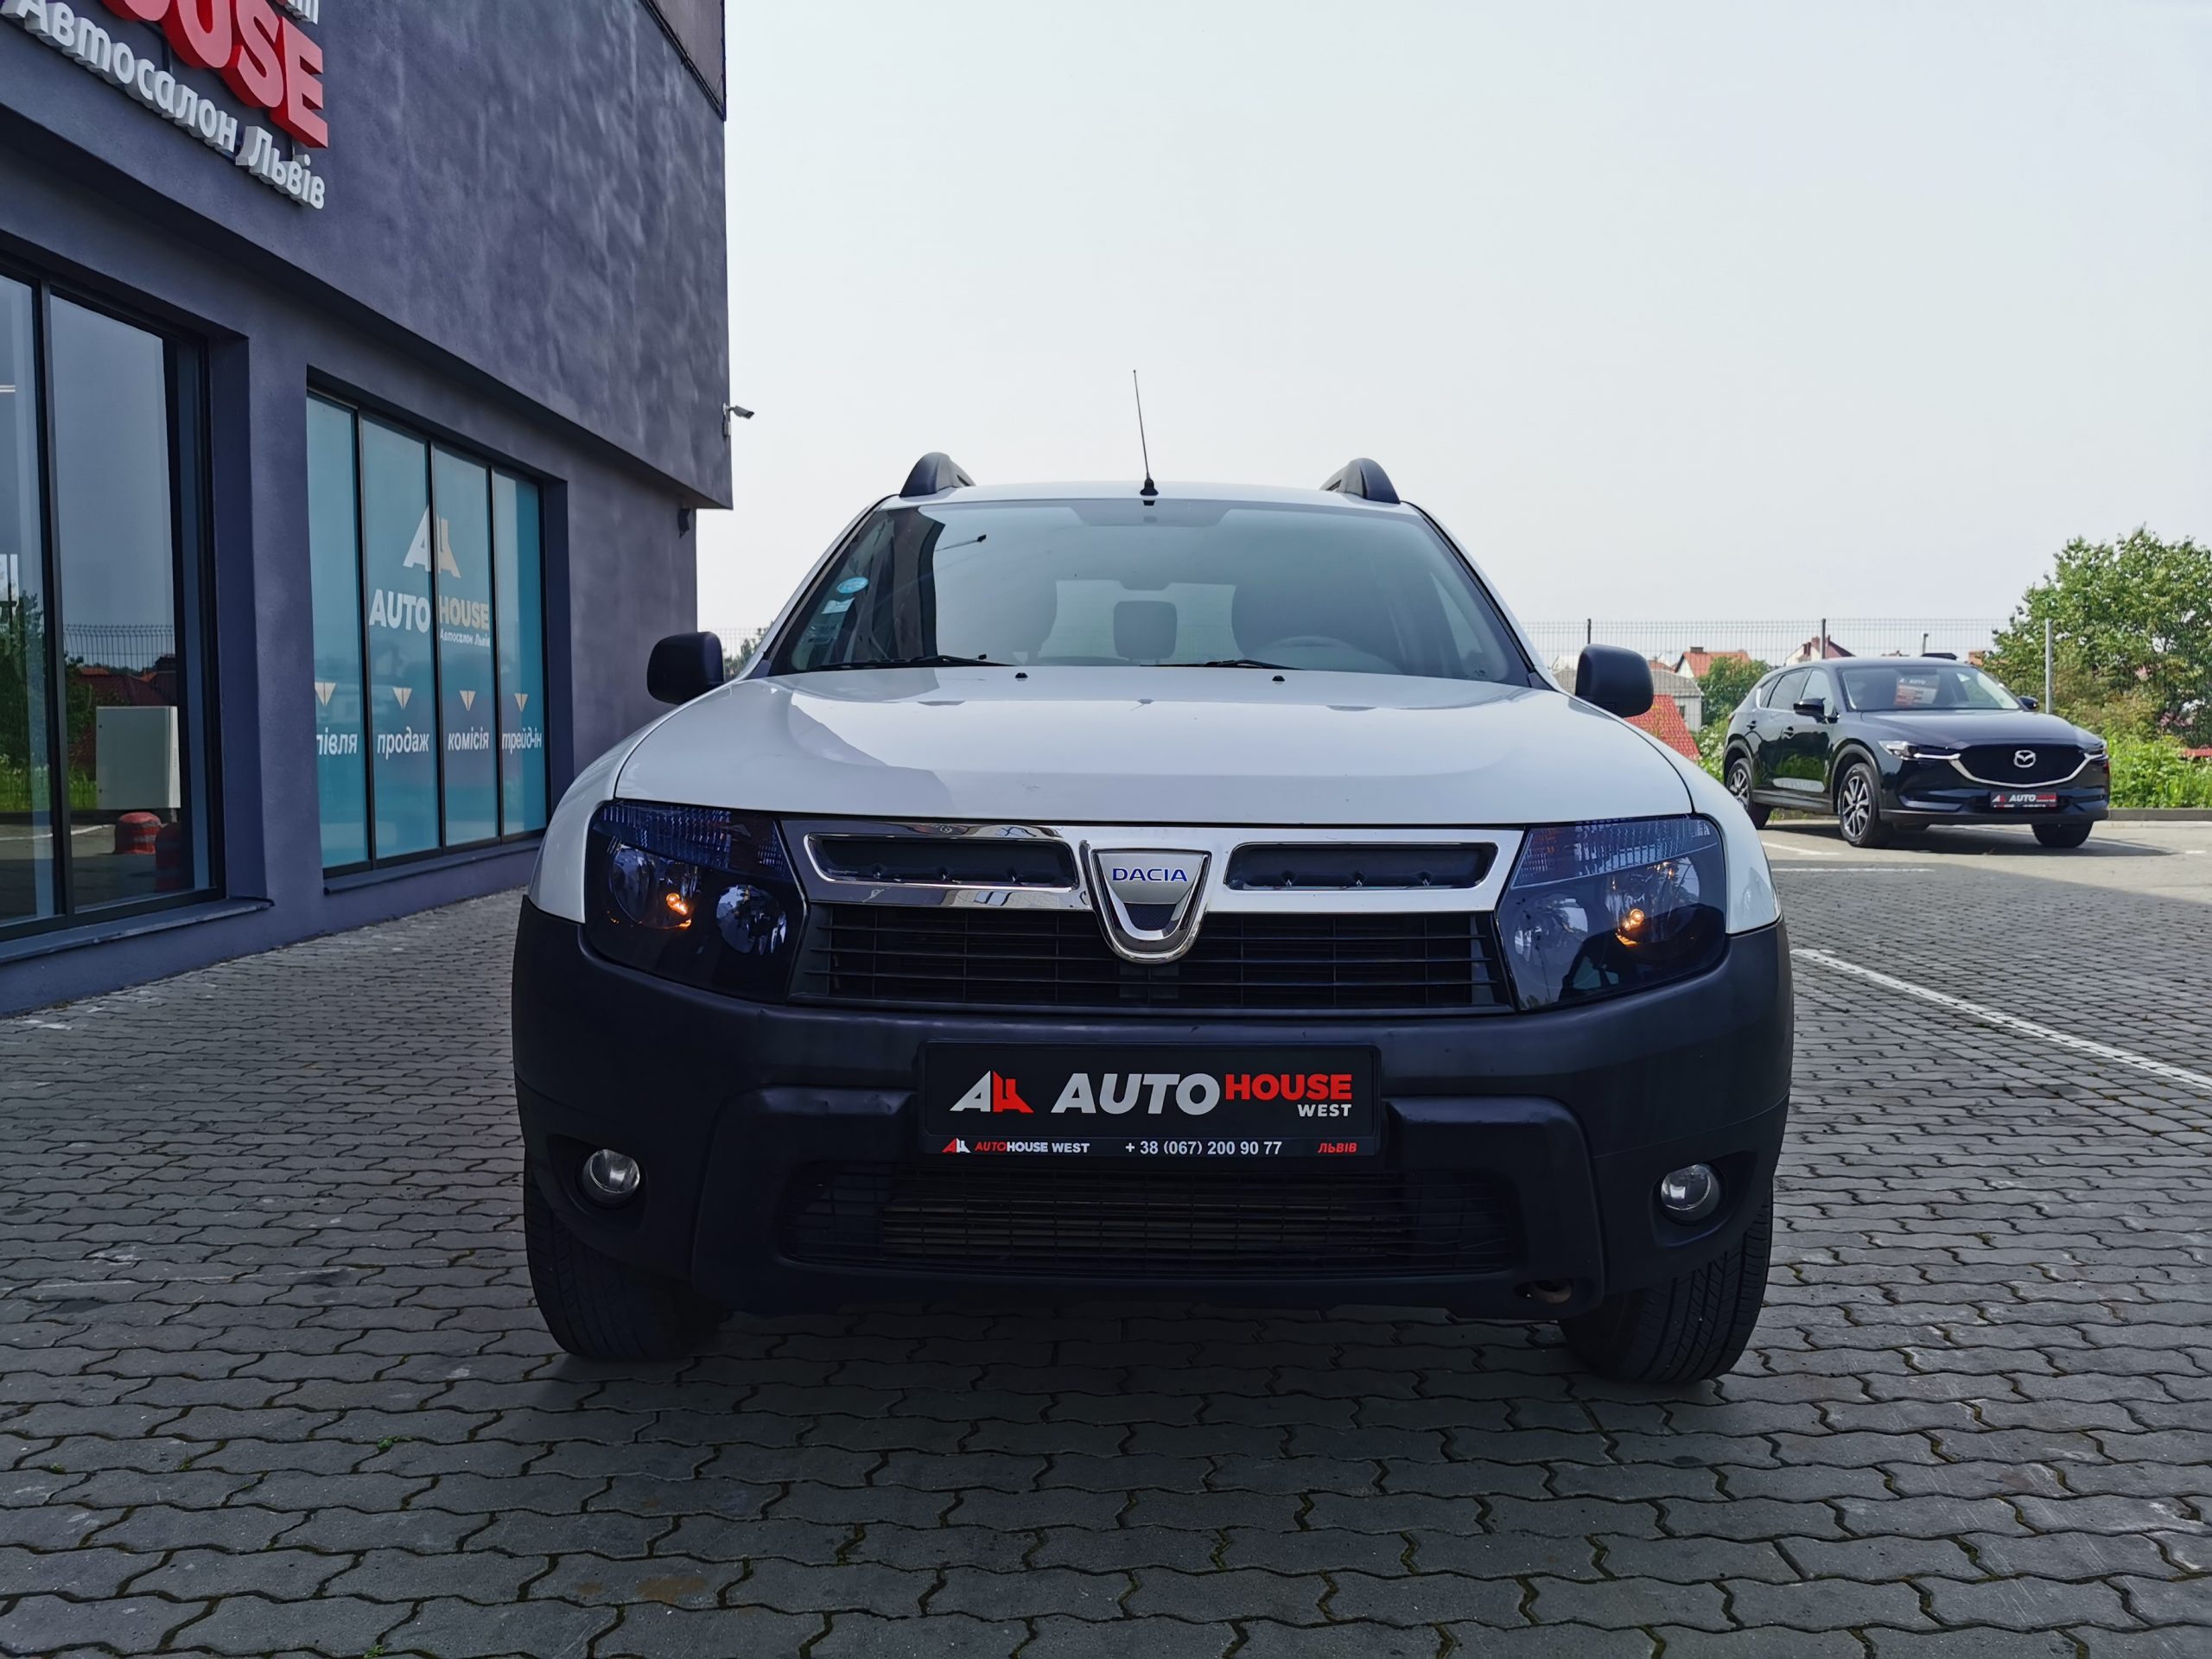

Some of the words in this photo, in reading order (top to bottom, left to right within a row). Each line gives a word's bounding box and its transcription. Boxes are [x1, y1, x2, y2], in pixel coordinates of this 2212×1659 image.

[102, 0, 328, 149] USE
[1, 0, 238, 154] Автосалон
[236, 125, 326, 210] Львів
[368, 588, 431, 633] AUTO
[439, 594, 490, 631] HOUSE
[377, 726, 429, 760] продаж
[448, 727, 489, 751] комісія
[502, 726, 542, 755] трейд-ін
[1112, 868, 1188, 882] DACIA
[1297, 1103, 1352, 1117] WEST
[975, 1141, 1048, 1154] AUTOHOUSE
[1052, 1142, 1090, 1154] WEST
[1140, 1141, 1159, 1154] 38
[1163, 1141, 1203, 1155] (067)
[1207, 1141, 1236, 1154] 200
[1240, 1141, 1259, 1154] 90
[1263, 1141, 1282, 1154] 77
[1318, 1142, 1357, 1154] ЛЬВІВ
